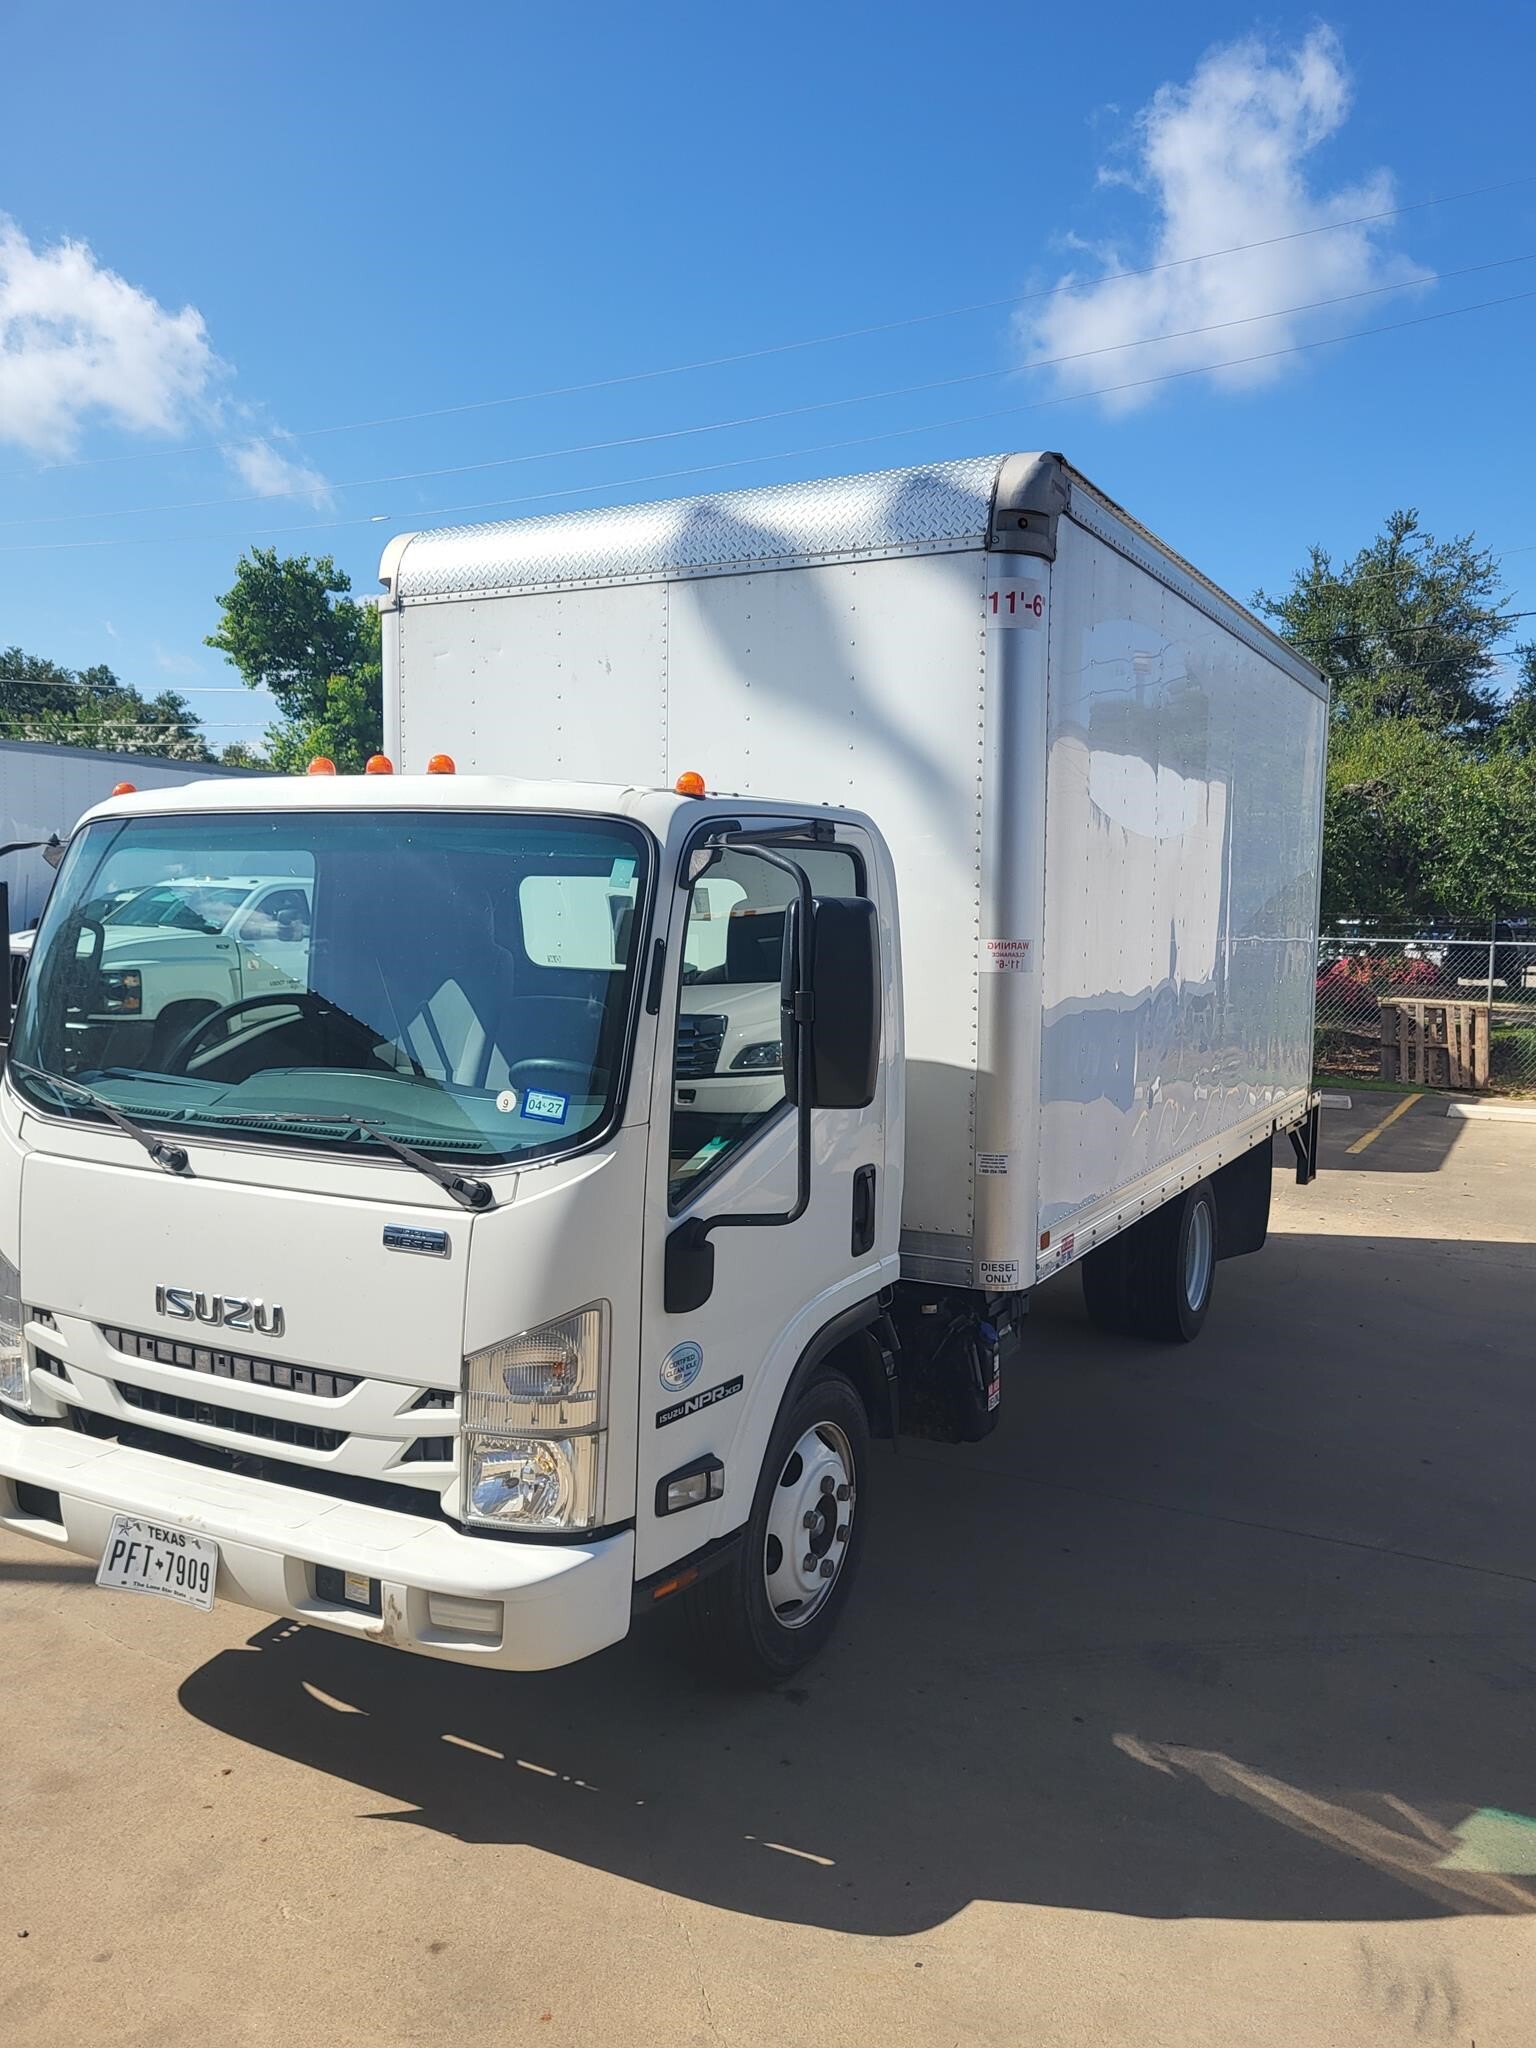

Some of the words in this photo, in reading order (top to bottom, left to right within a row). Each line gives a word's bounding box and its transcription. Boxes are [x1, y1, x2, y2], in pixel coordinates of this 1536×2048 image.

[981, 1262, 1016, 1272] DIESEL
[985, 1274, 1013, 1283] ONLY
[155, 1283, 286, 1338] ISUZU
[669, 1354, 695, 1369] CERTIFIED
[666, 1365, 684, 1378] CLEAN
[659, 1406, 684, 1423] ISUZU
[148, 1525, 186, 1547] TEXAS
[146, 1582, 160, 1591] Lone
